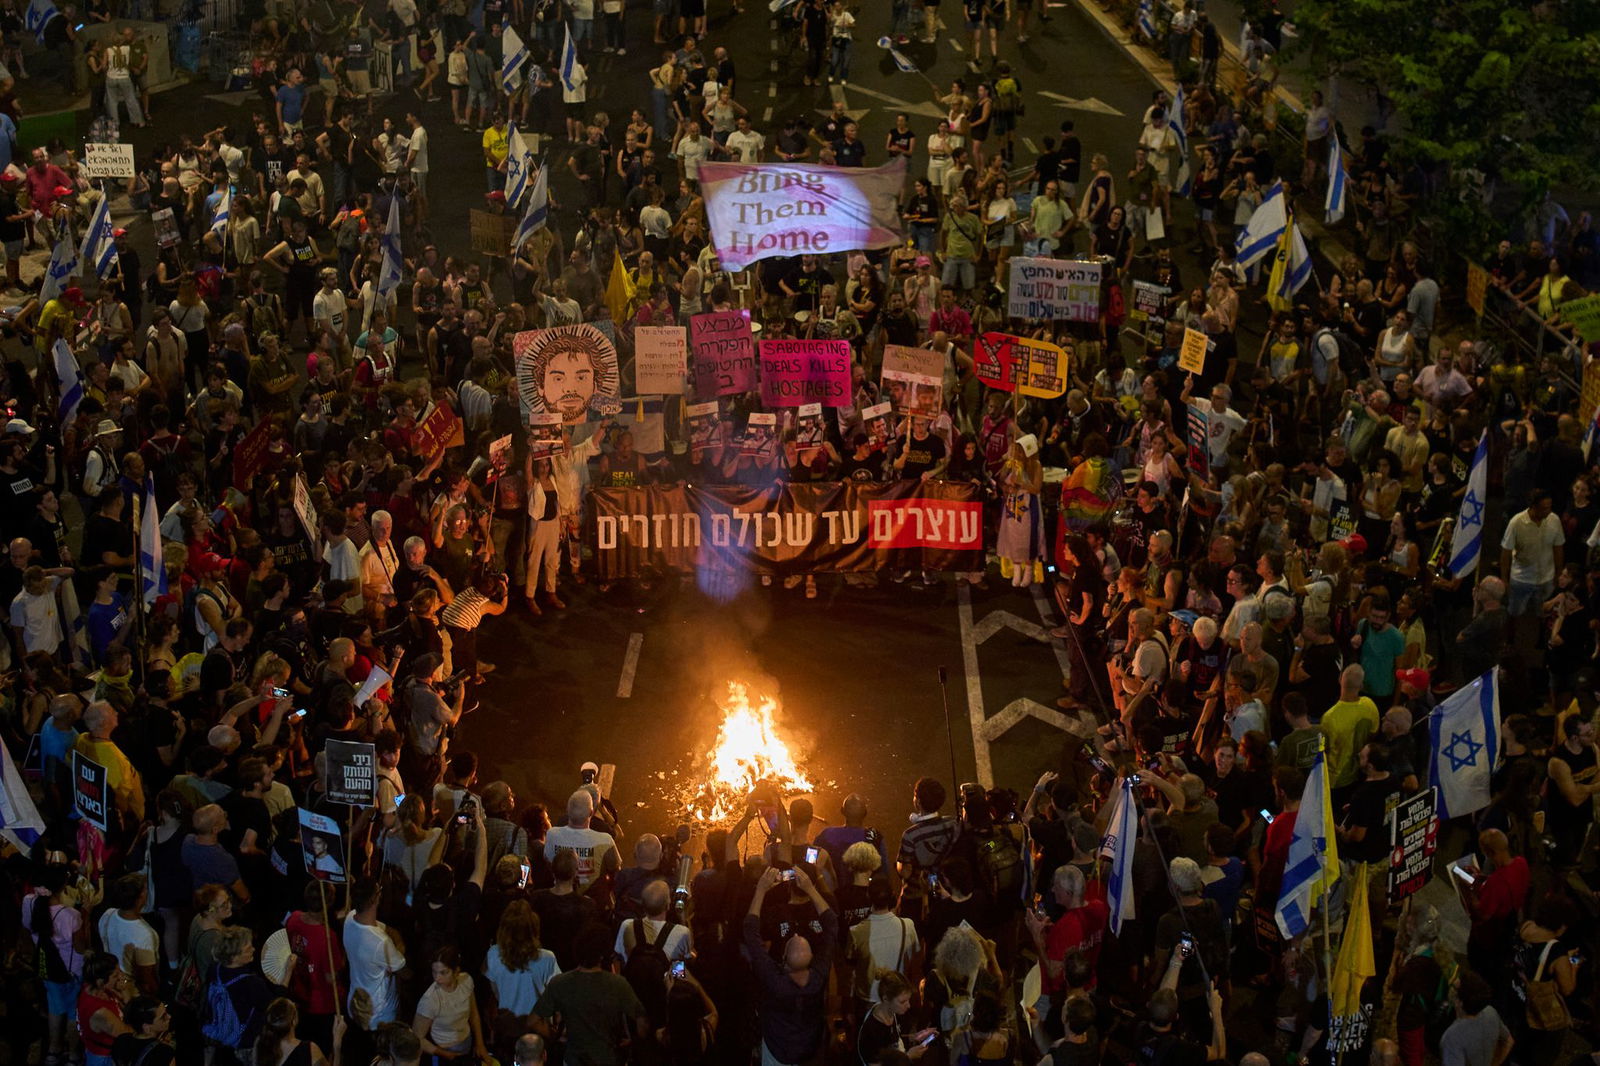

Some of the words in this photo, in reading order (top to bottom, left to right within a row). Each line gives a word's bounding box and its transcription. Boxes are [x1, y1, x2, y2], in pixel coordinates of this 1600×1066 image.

[736, 168, 826, 194] Bring
[731, 199, 828, 226] Them
[729, 229, 830, 256] Home
[1020, 265, 1054, 281] החפץ
[1055, 267, 1085, 281] האיש
[1086, 271, 1099, 283] מי
[1028, 300, 1054, 318] שלום
[696, 316, 746, 334] מבצע
[700, 336, 750, 356] הפקרת
[763, 341, 848, 357] SABOTAGING
[765, 359, 803, 374] DEALS
[809, 358, 847, 374] KILLS
[771, 379, 844, 397] HOSTAGES
[611, 471, 636, 480] SEAL
[597, 511, 701, 551] חוזרים
[711, 506, 813, 549] שכולם
[821, 509, 860, 547] עד
[872, 505, 979, 545] עוצרים
[352, 754, 372, 766] ביבי
[81, 764, 96, 782] עם
[345, 778, 372, 790] מהעם
[576, 847, 595, 858] THEM
